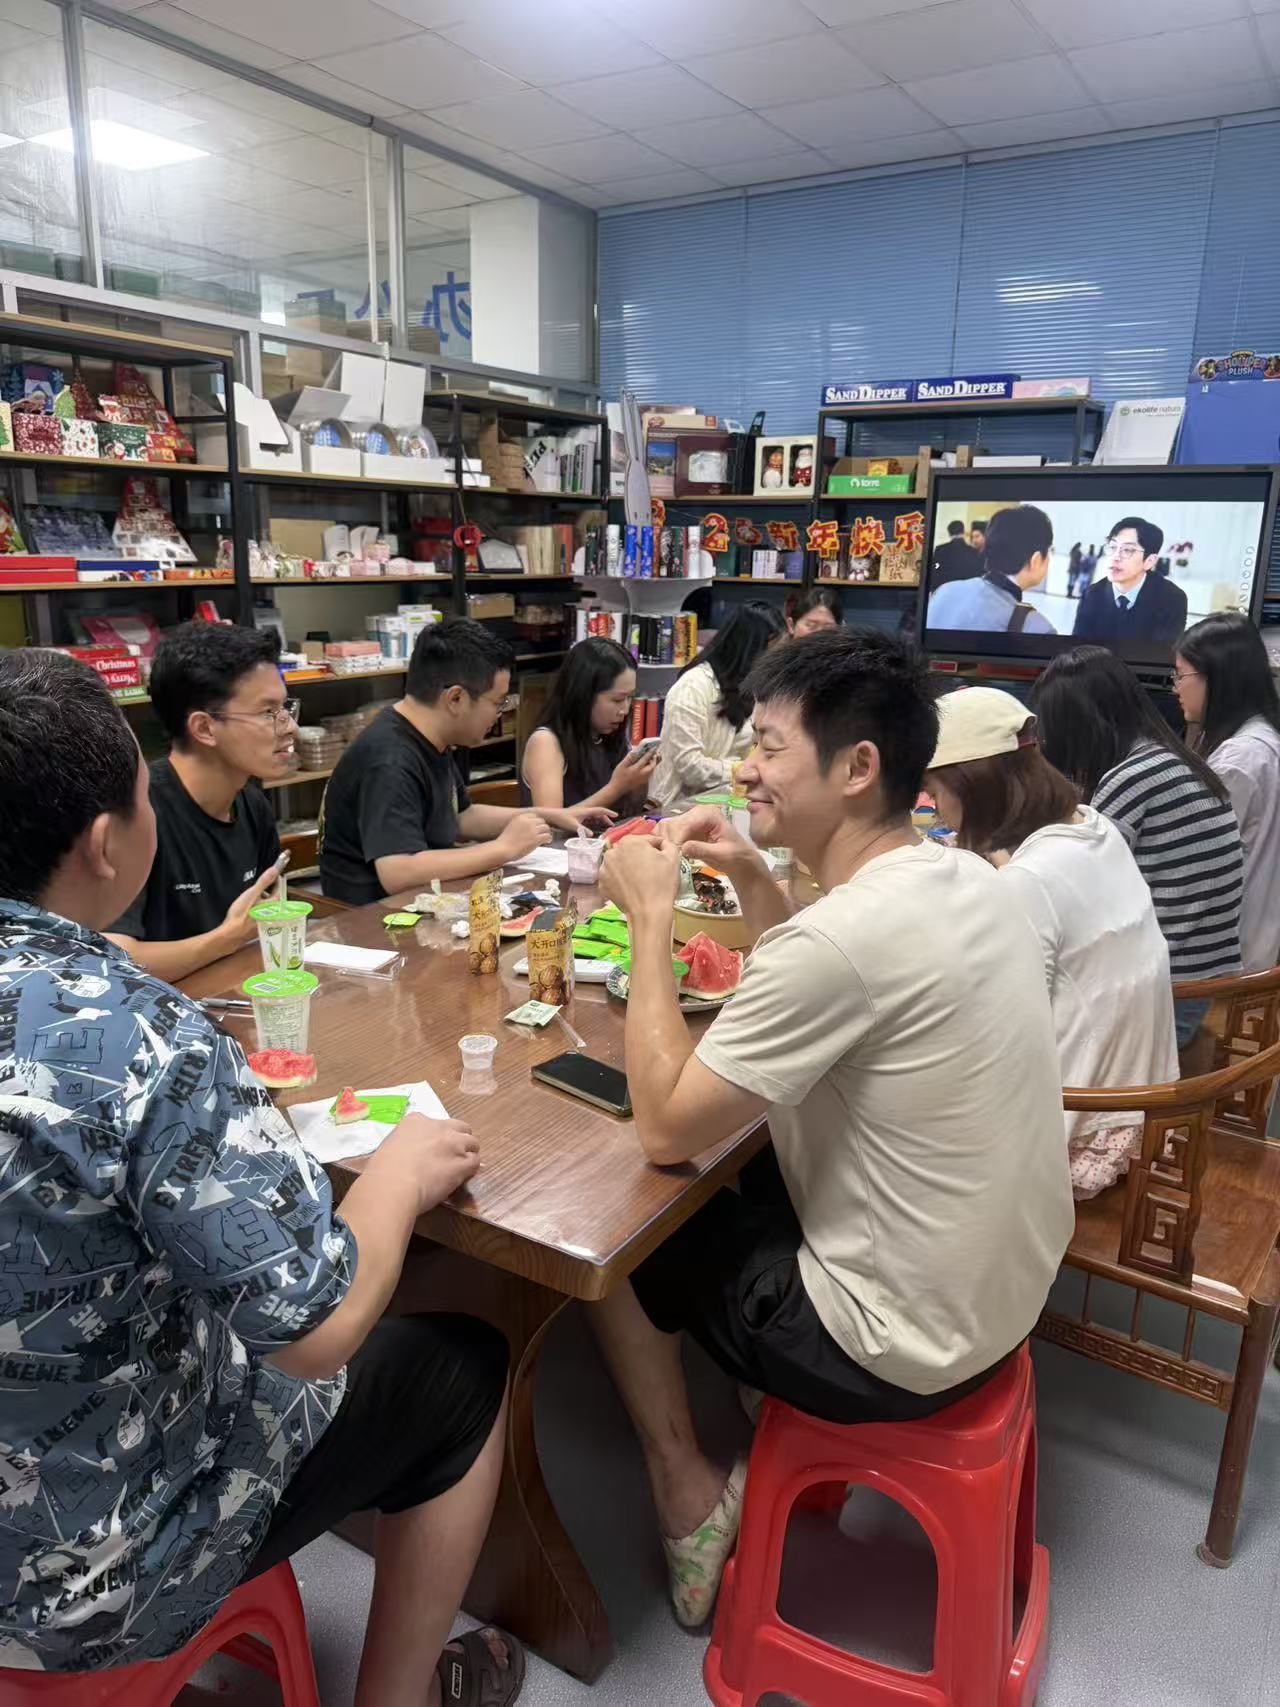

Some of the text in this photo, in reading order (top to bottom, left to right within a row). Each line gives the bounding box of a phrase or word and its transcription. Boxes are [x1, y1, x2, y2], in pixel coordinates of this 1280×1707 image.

[1228, 367, 1253, 375] PLUSH
[825, 385, 907, 401] SAND DIPPER
[918, 380, 1006, 398] SAND DIPPER
[1133, 405, 1158, 414] ekolife
[96, 660, 136, 671] Christmas
